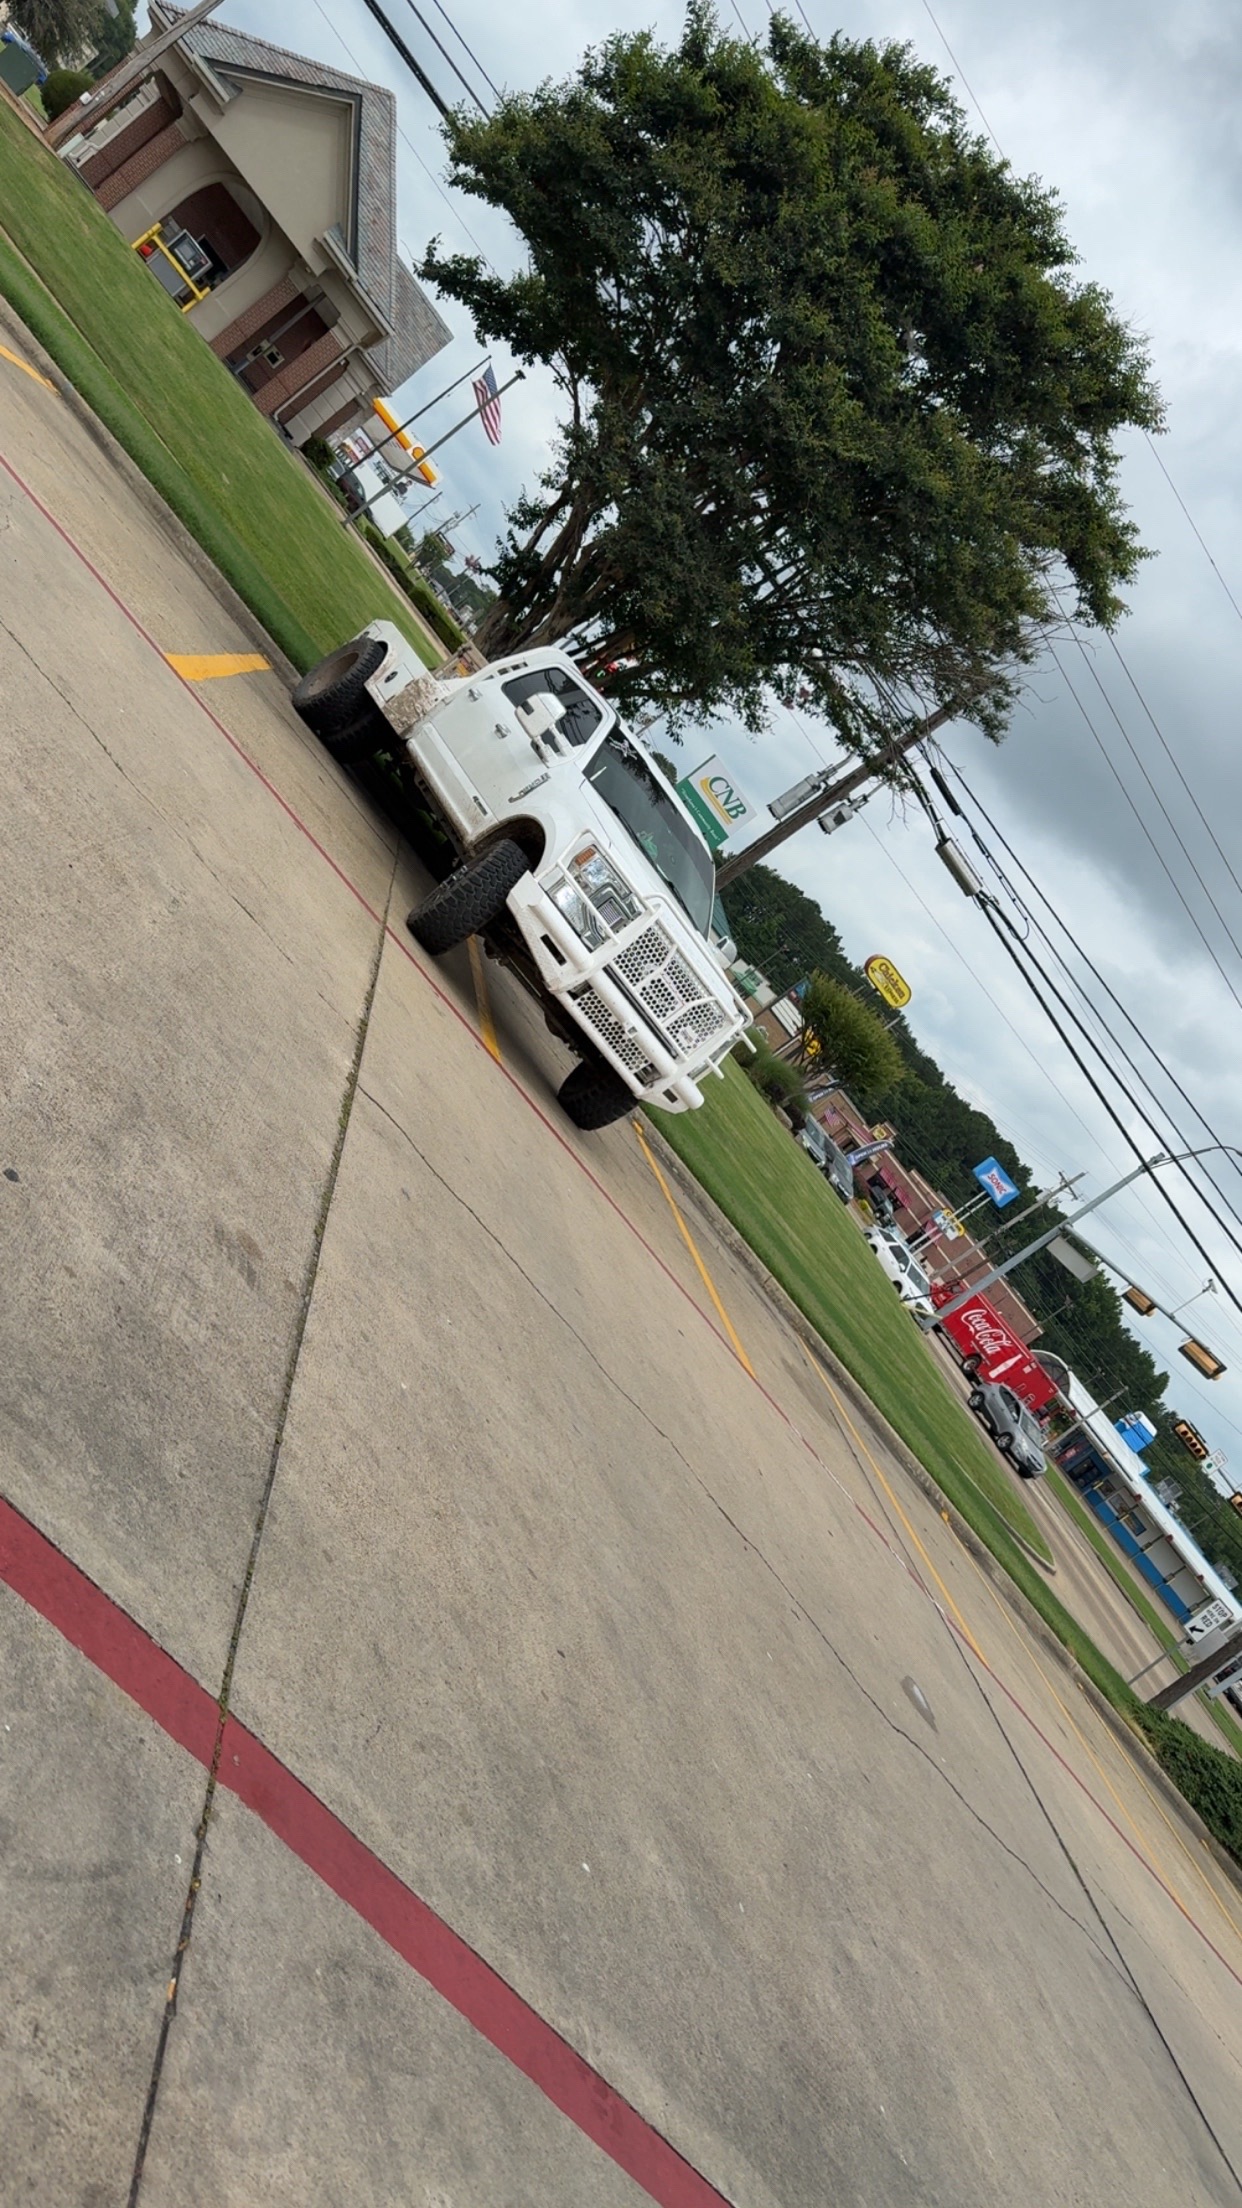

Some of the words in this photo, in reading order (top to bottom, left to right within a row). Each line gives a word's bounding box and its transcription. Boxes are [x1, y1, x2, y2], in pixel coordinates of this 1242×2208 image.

[709, 776, 747, 819] CNB
[879, 962, 906, 1000] Chicken
[987, 1173, 1008, 1195] SONIC
[1200, 1614, 1213, 1628] RED
[1211, 1603, 1228, 1618] STOP
